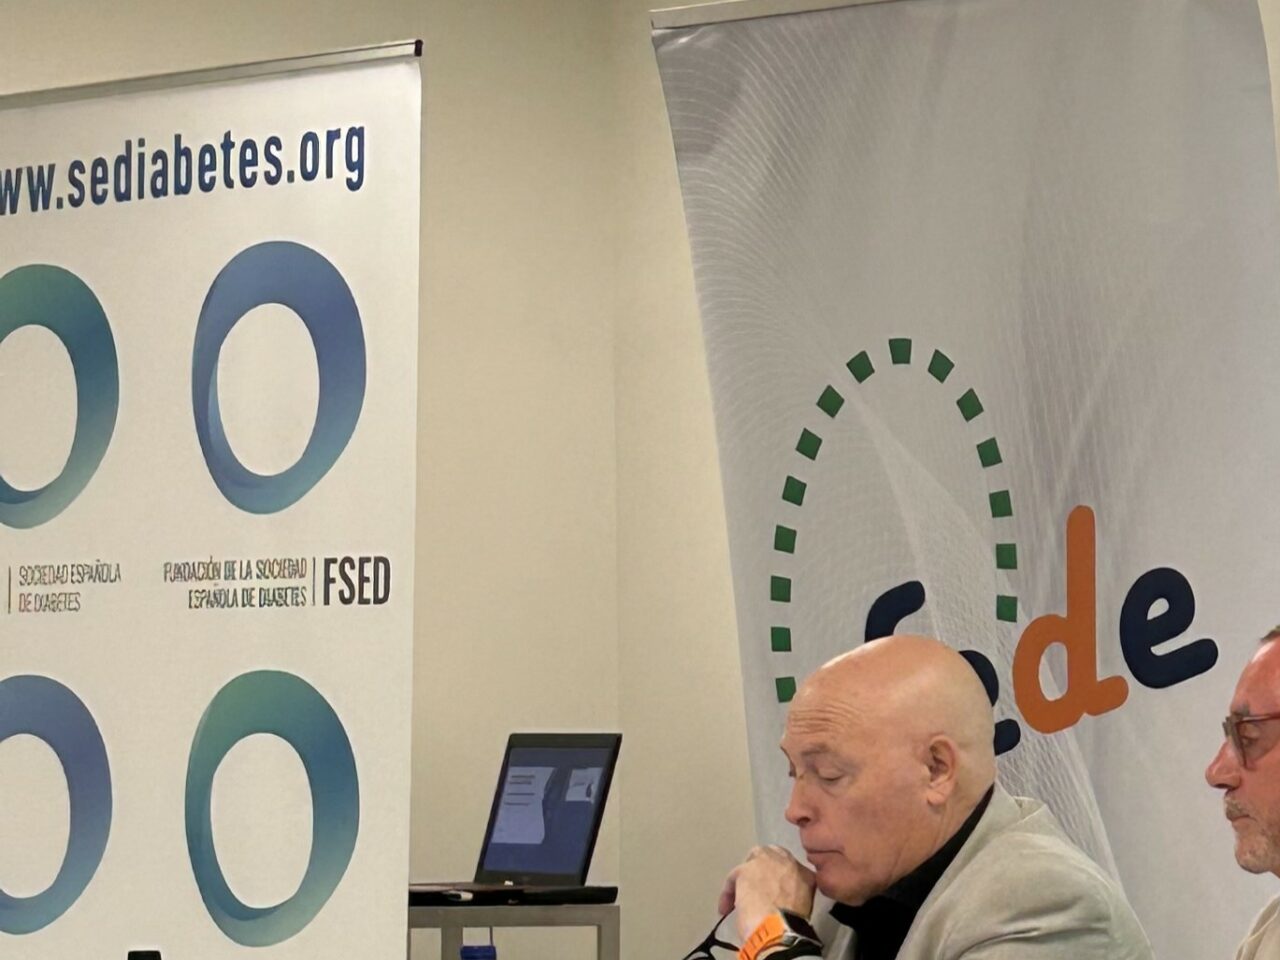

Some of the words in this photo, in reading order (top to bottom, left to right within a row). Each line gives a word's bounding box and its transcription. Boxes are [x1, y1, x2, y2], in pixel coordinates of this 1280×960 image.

[0, 126, 365, 216] ww.sediabetes.org
[239, 559, 252, 580] LA
[323, 556, 391, 606] FSED
[241, 587, 256, 608] DE
